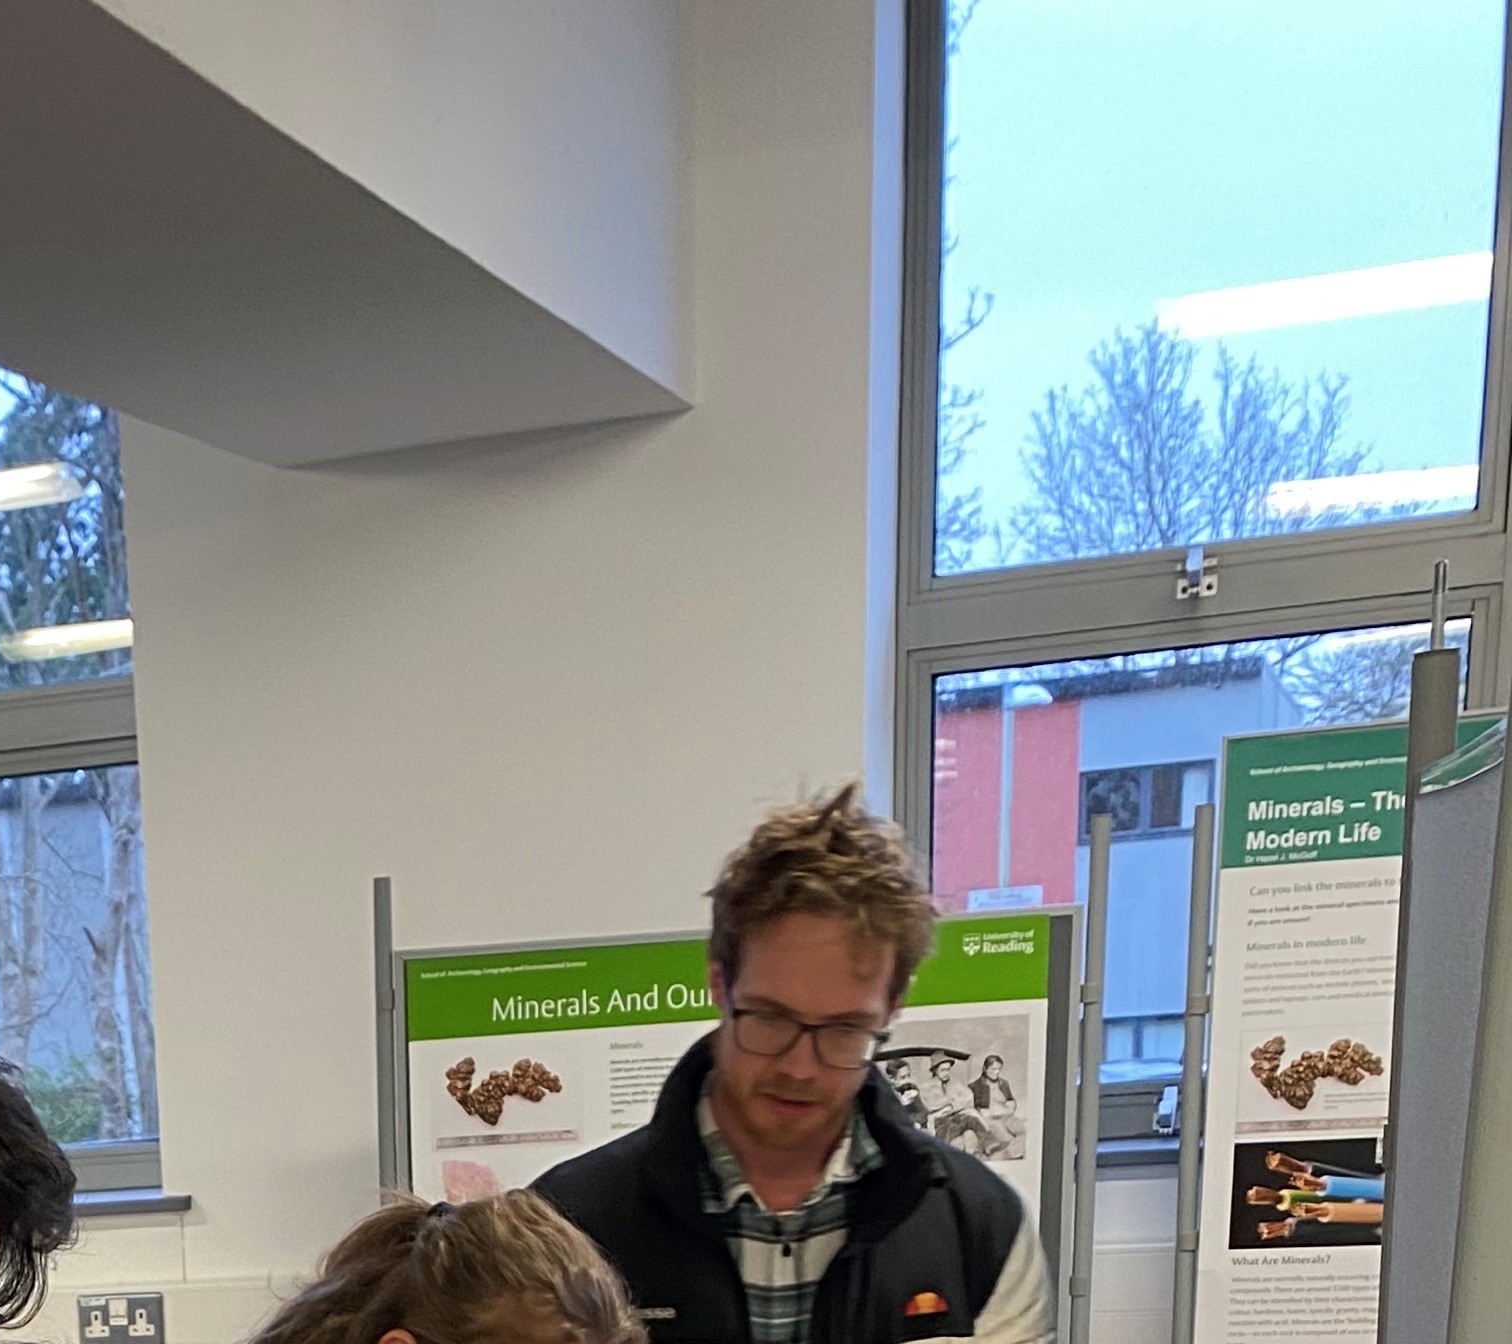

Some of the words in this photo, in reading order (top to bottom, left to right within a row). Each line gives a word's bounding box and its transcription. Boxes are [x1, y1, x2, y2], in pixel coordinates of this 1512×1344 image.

[1247, 795, 1345, 821] Minerals
[1245, 828, 1332, 851] Modern
[1338, 821, 1382, 844] Life
[1249, 885, 1270, 897] Can
[1271, 885, 1292, 897] you
[1293, 881, 1313, 894] link
[1315, 880, 1333, 892] the
[1335, 877, 1382, 891] minerals
[982, 939, 1035, 955] Reading
[1246, 941, 1292, 952] Minerals
[1305, 937, 1348, 949] modern
[492, 988, 601, 1022] Minerals
[606, 983, 658, 1013] And
[1231, 1256, 1260, 1266] What
[1261, 1255, 1279, 1265] Are
[1281, 1254, 1332, 1266] Minerals?
